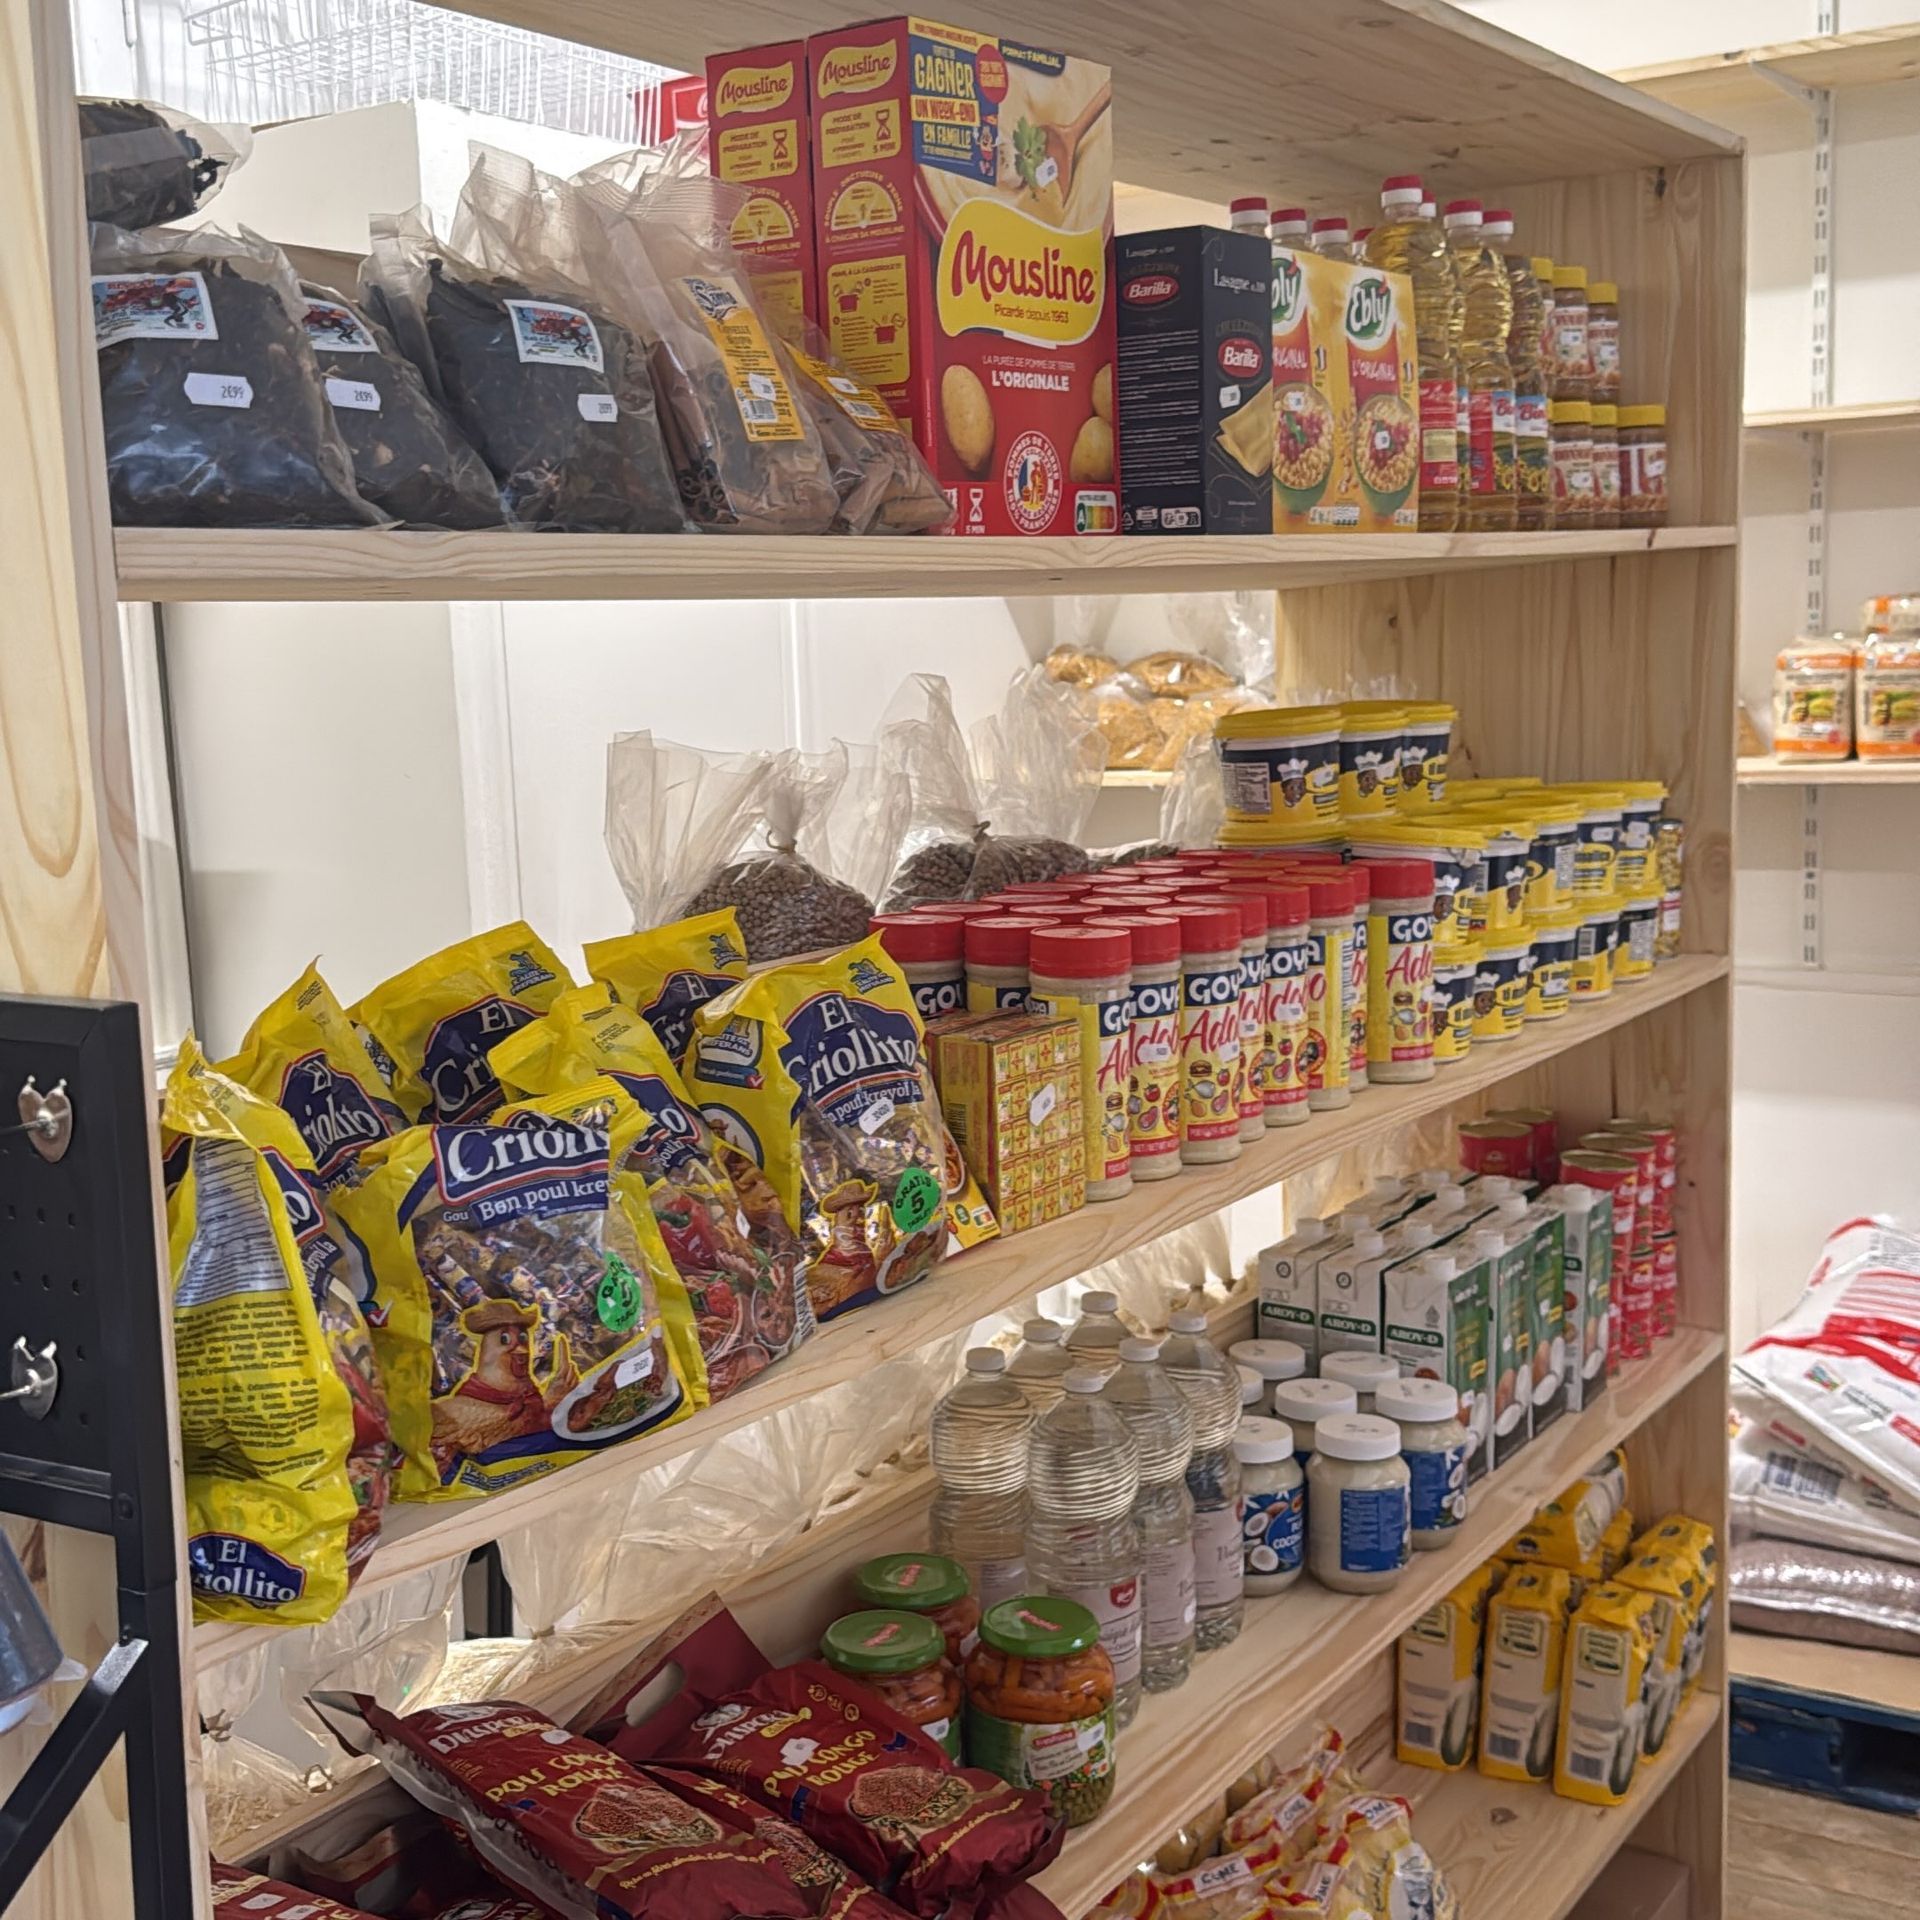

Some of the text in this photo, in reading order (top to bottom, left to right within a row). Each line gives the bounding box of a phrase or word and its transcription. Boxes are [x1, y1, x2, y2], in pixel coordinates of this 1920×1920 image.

[823, 55, 892, 86] Mousline
[721, 77, 788, 105] Mousline
[916, 99, 930, 118] UN
[951, 229, 1096, 305] Mousline
[1129, 281, 1172, 298] Barilla
[1351, 284, 1387, 338] Ebly
[1223, 347, 1258, 368] Barilla
[991, 369, 1071, 392] L'ORIGINALE
[971, 525, 985, 534] MIN
[479, 1003, 517, 1034] El
[818, 997, 855, 1033] El
[478, 1195, 522, 1221] Bon
[523, 1182, 570, 1207] poul
[910, 1192, 926, 1215] 5
[443, 1211, 469, 1223] Gou
[1264, 1306, 1311, 1322] AROY-D
[1324, 1317, 1372, 1333] AROY-D
[1390, 1328, 1439, 1345] AROY-D
[219, 1539, 248, 1565] El
[194, 1566, 298, 1602] riollito
[808, 1730, 876, 1767] CONGO
[539, 1763, 630, 1797] ROUGE
[805, 1750, 879, 1788] ROUGE
[485, 1767, 547, 1803] POIS
